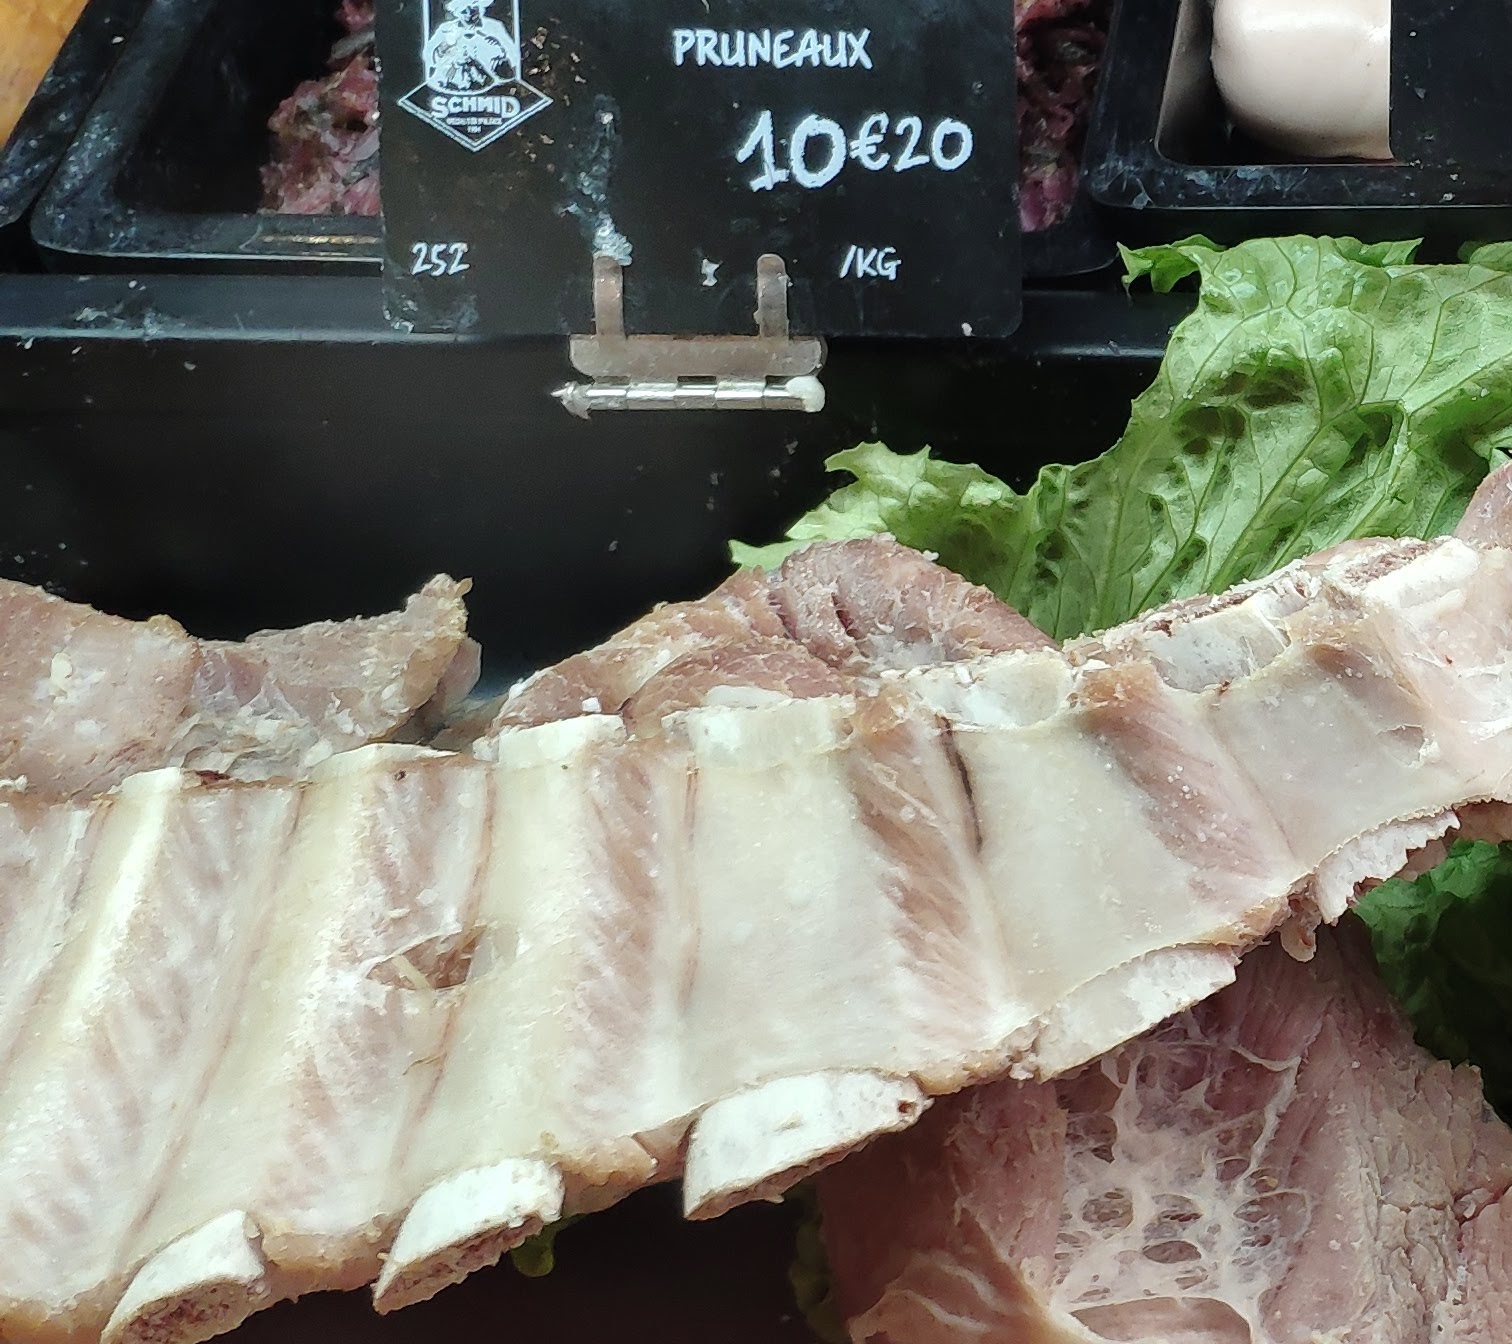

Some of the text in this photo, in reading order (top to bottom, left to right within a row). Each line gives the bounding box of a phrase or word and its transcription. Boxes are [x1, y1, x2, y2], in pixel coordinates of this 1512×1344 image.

[672, 28, 874, 69] PRUNEAUX
[430, 95, 521, 119] SCHMID
[735, 109, 973, 192] 10€20
[411, 242, 471, 277] 252
[839, 244, 902, 281] /KG
